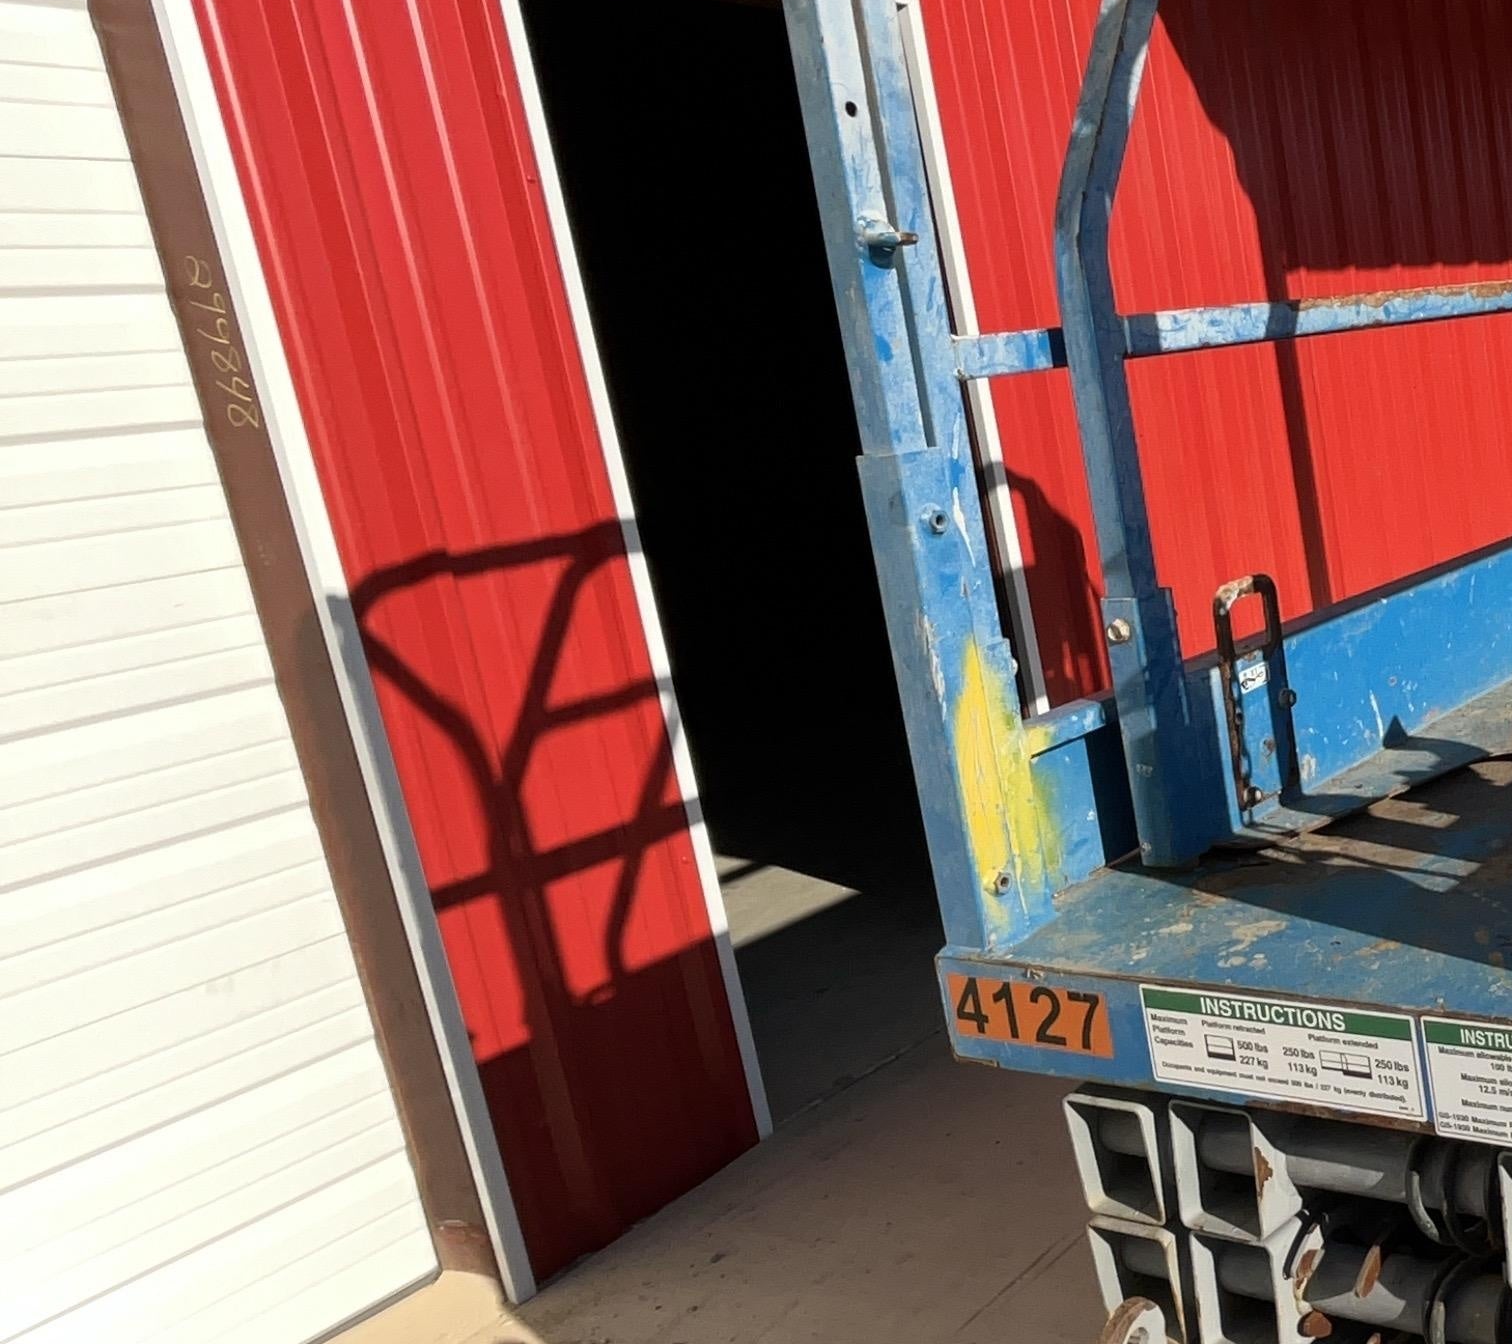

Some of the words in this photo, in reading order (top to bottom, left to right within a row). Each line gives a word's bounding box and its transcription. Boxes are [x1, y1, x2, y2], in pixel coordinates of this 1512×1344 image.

[957, 977, 1100, 1050] 4127
[1151, 1013, 1188, 1025] Maximum
[1200, 997, 1345, 1031] INSTRUCTIONS
[1152, 1025, 1186, 1036] Platform
[1202, 1019, 1231, 1031] Platform
[1233, 1025, 1266, 1035] retracted
[1154, 1036, 1194, 1048] Capacities
[1237, 1040, 1253, 1051] 500
[1254, 1042, 1268, 1053] lbs
[1307, 1034, 1340, 1044] Platform
[1342, 1039, 1378, 1049] extended
[1282, 1047, 1299, 1057] 250
[1300, 1049, 1315, 1059] lbs
[1239, 1055, 1255, 1066] 227
[1256, 1058, 1268, 1070] kg
[1288, 1062, 1304, 1073] 113
[1305, 1064, 1317, 1077] kg
[1375, 1059, 1392, 1070] 250
[1394, 1061, 1410, 1072] lbs
[1378, 1075, 1394, 1086] 113
[1397, 1077, 1409, 1090] kg
[1478, 1085, 1497, 1095] 12.5
